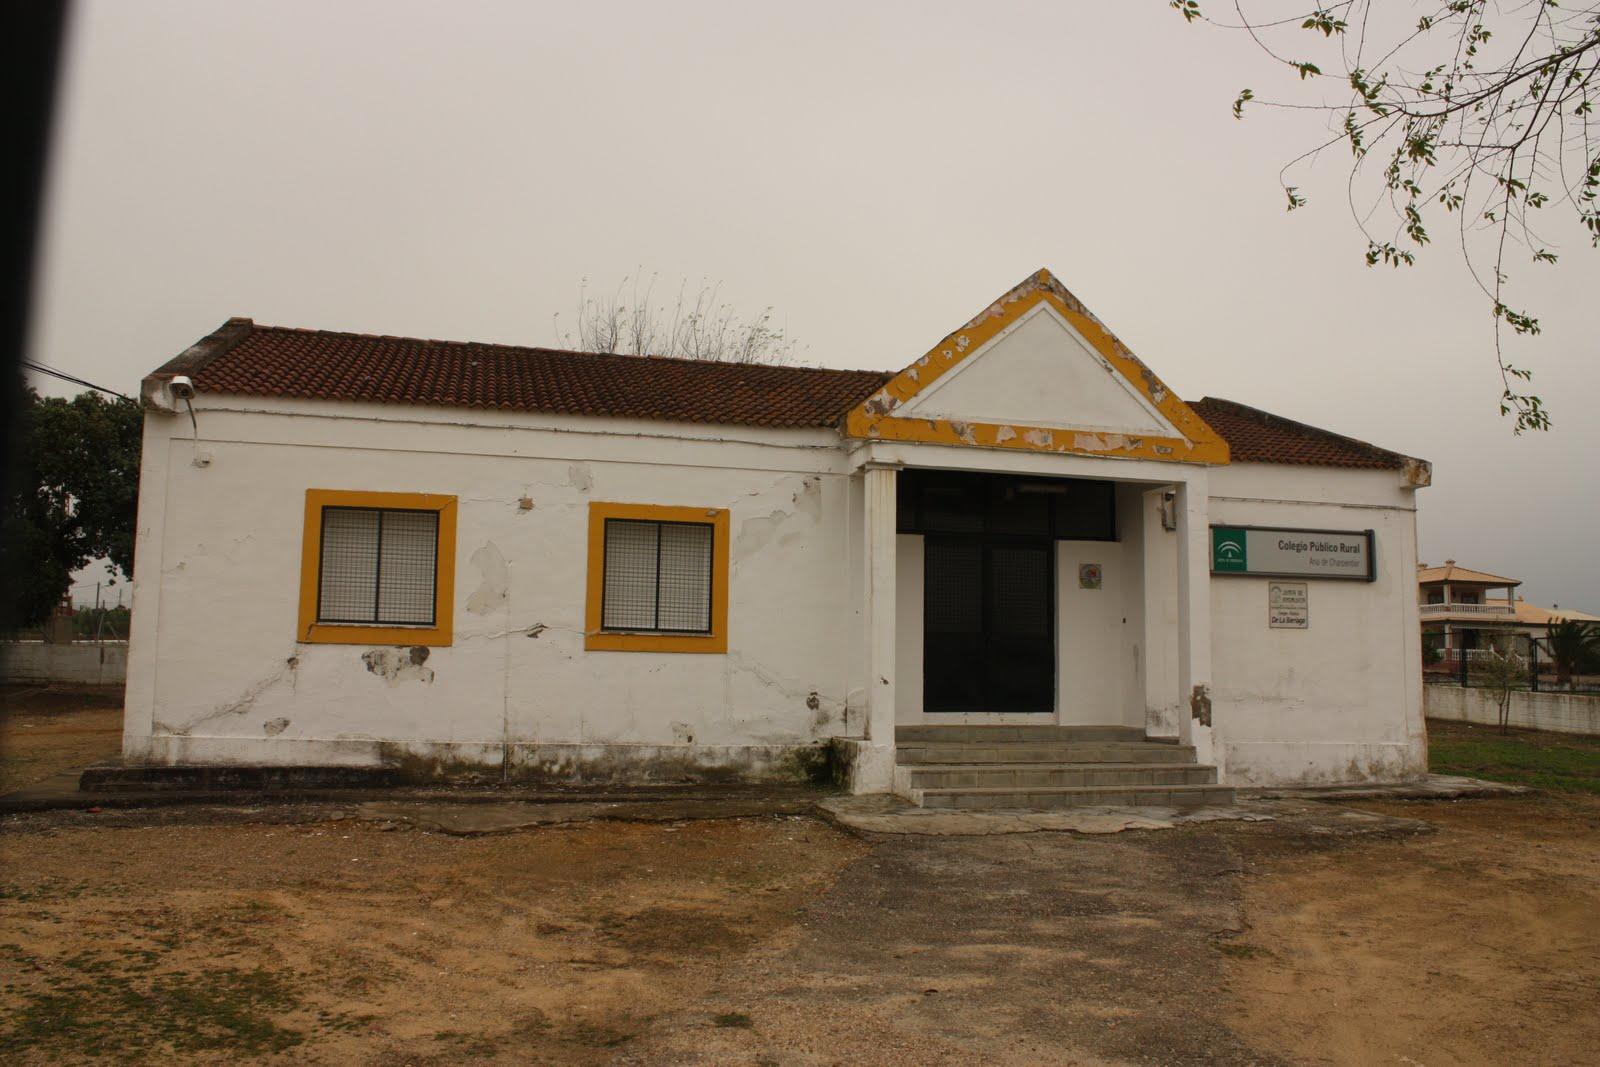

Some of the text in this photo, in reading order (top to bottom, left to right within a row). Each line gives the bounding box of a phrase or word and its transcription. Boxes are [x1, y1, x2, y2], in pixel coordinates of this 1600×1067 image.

[1278, 540, 1360, 553] Colegio Público Rural
[1309, 557, 1320, 566] Ana
[1321, 557, 1328, 566] de
